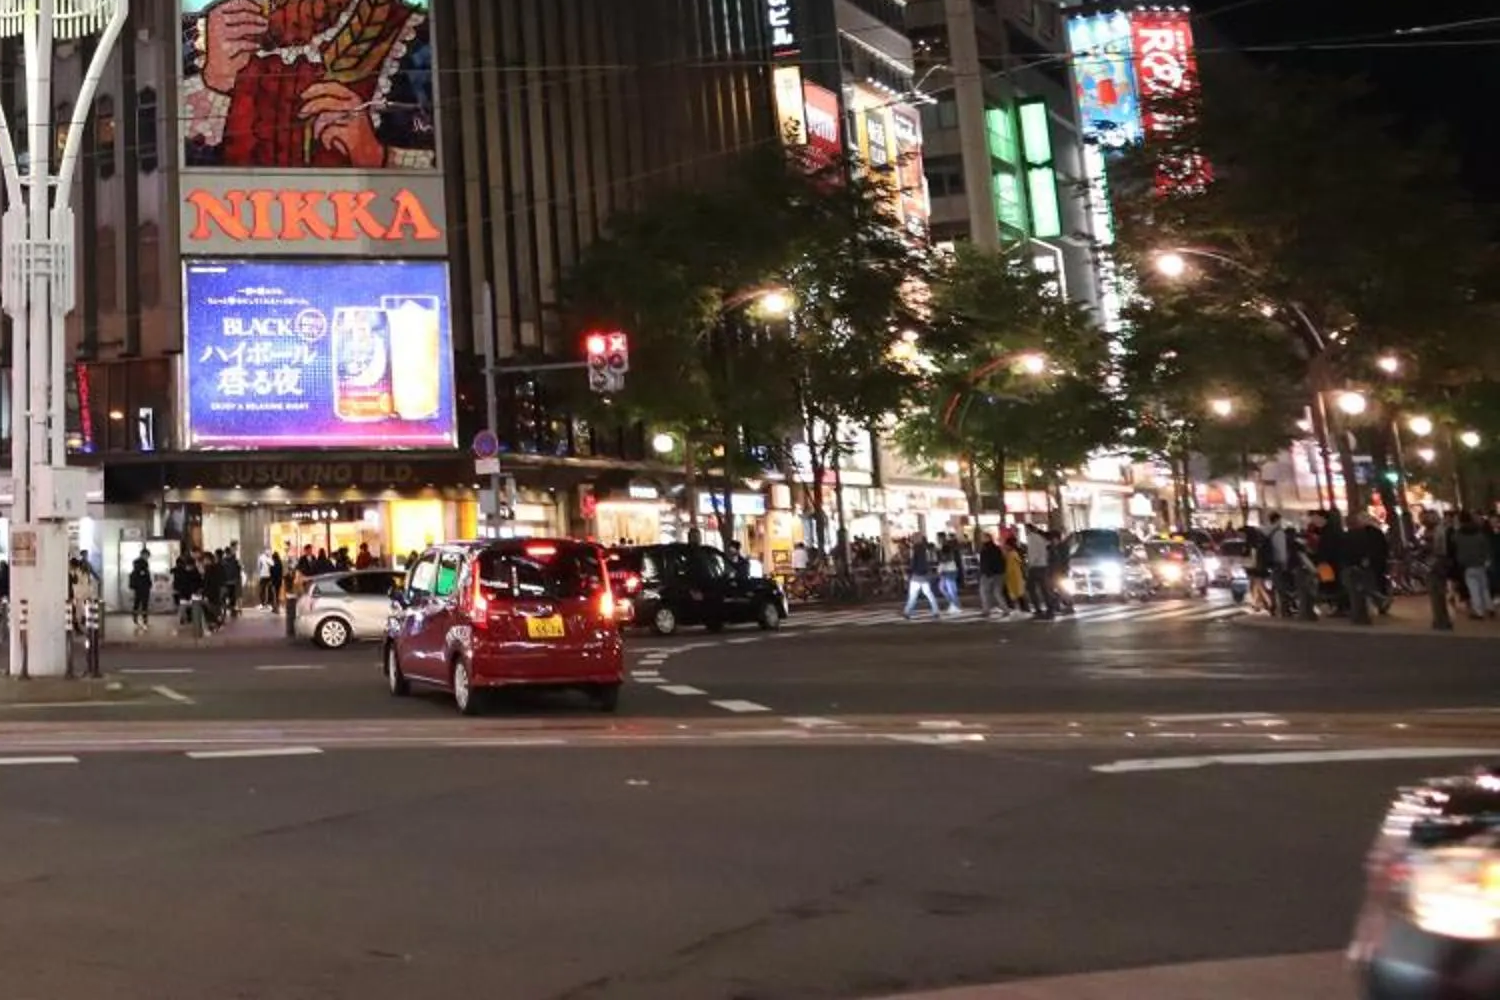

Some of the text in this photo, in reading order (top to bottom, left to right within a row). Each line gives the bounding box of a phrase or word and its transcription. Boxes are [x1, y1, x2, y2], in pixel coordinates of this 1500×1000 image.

[185, 187, 443, 242] NIKKA
[222, 317, 296, 338] BLACK
[199, 340, 319, 368] ハイボール
[216, 366, 304, 397] 香る夜
[220, 463, 353, 484] SUSUKINO
